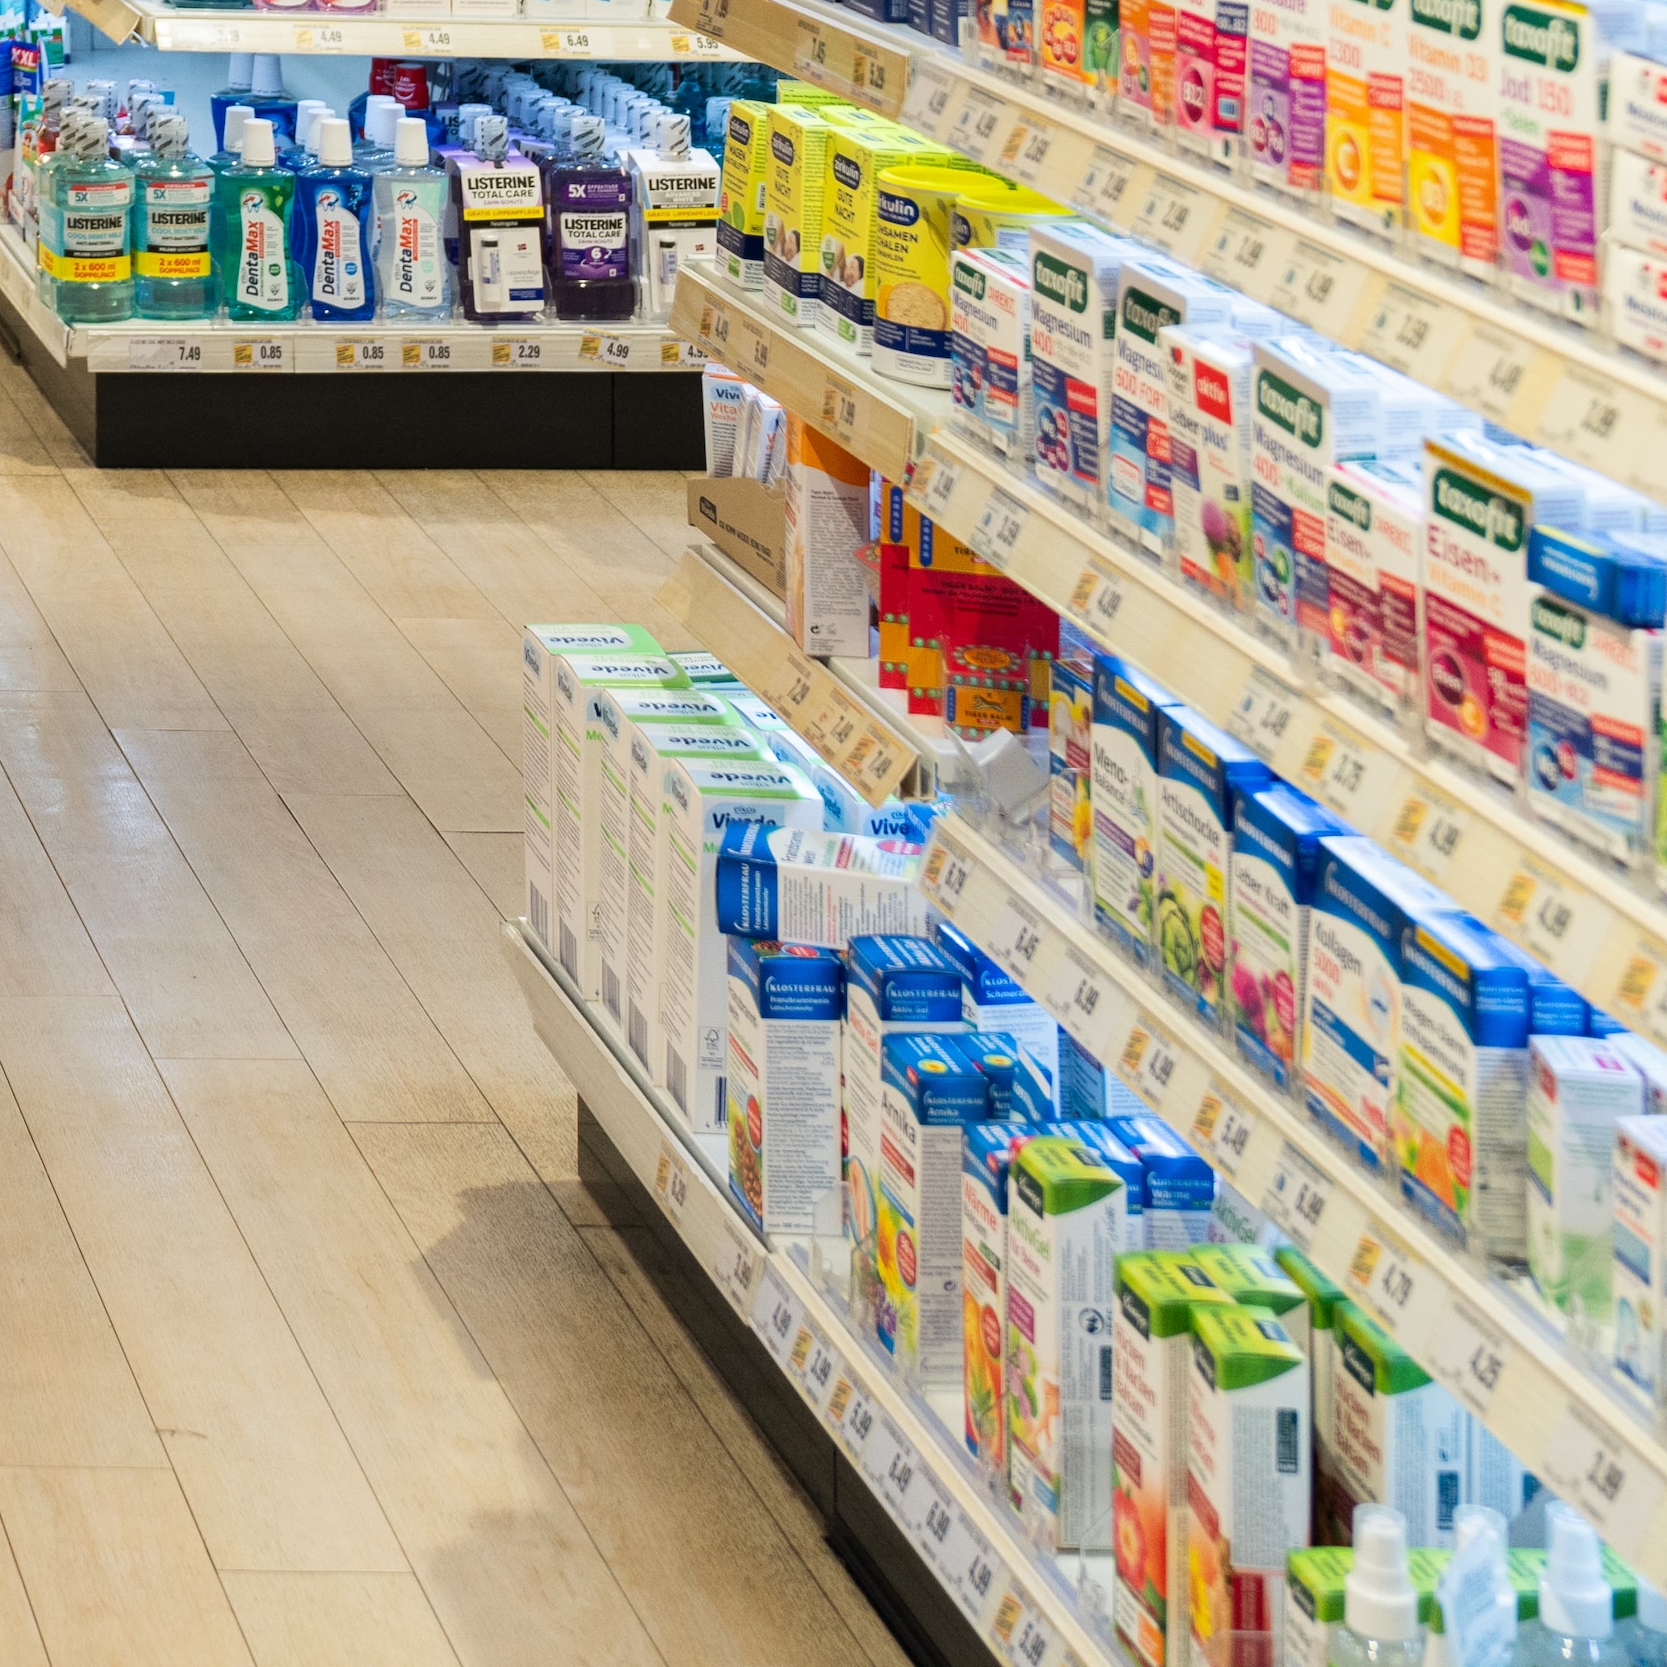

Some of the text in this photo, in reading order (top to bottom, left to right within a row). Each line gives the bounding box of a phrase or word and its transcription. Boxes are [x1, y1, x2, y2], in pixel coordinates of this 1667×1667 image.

[320, 30, 342, 43] 4.49
[429, 32, 451, 45] 4.49
[568, 34, 589, 47] 6.49
[468, 175, 536, 190] LISTERINE
[472, 189, 534, 198] TOTAL CARE
[568, 184, 586, 198] 5X
[67, 215, 123, 230] LISTERINE
[151, 211, 207, 225] LISTERINE
[564, 217, 624, 231] LISTERINE
[567, 230, 621, 239] TOTAL CARE
[179, 346, 201, 360] 7.49
[260, 345, 282, 359] 0.85
[362, 345, 384, 360] 0.85
[428, 345, 450, 360] 0.85
[518, 345, 541, 359] 2.29
[607, 342, 630, 358] 4.99
[710, 770, 794, 785] Vivede
[769, 983, 837, 993] KLOSTERFRAU
[889, 988, 960, 999] KLOSTERFRAU
[927, 1106, 960, 1117] Arnika
